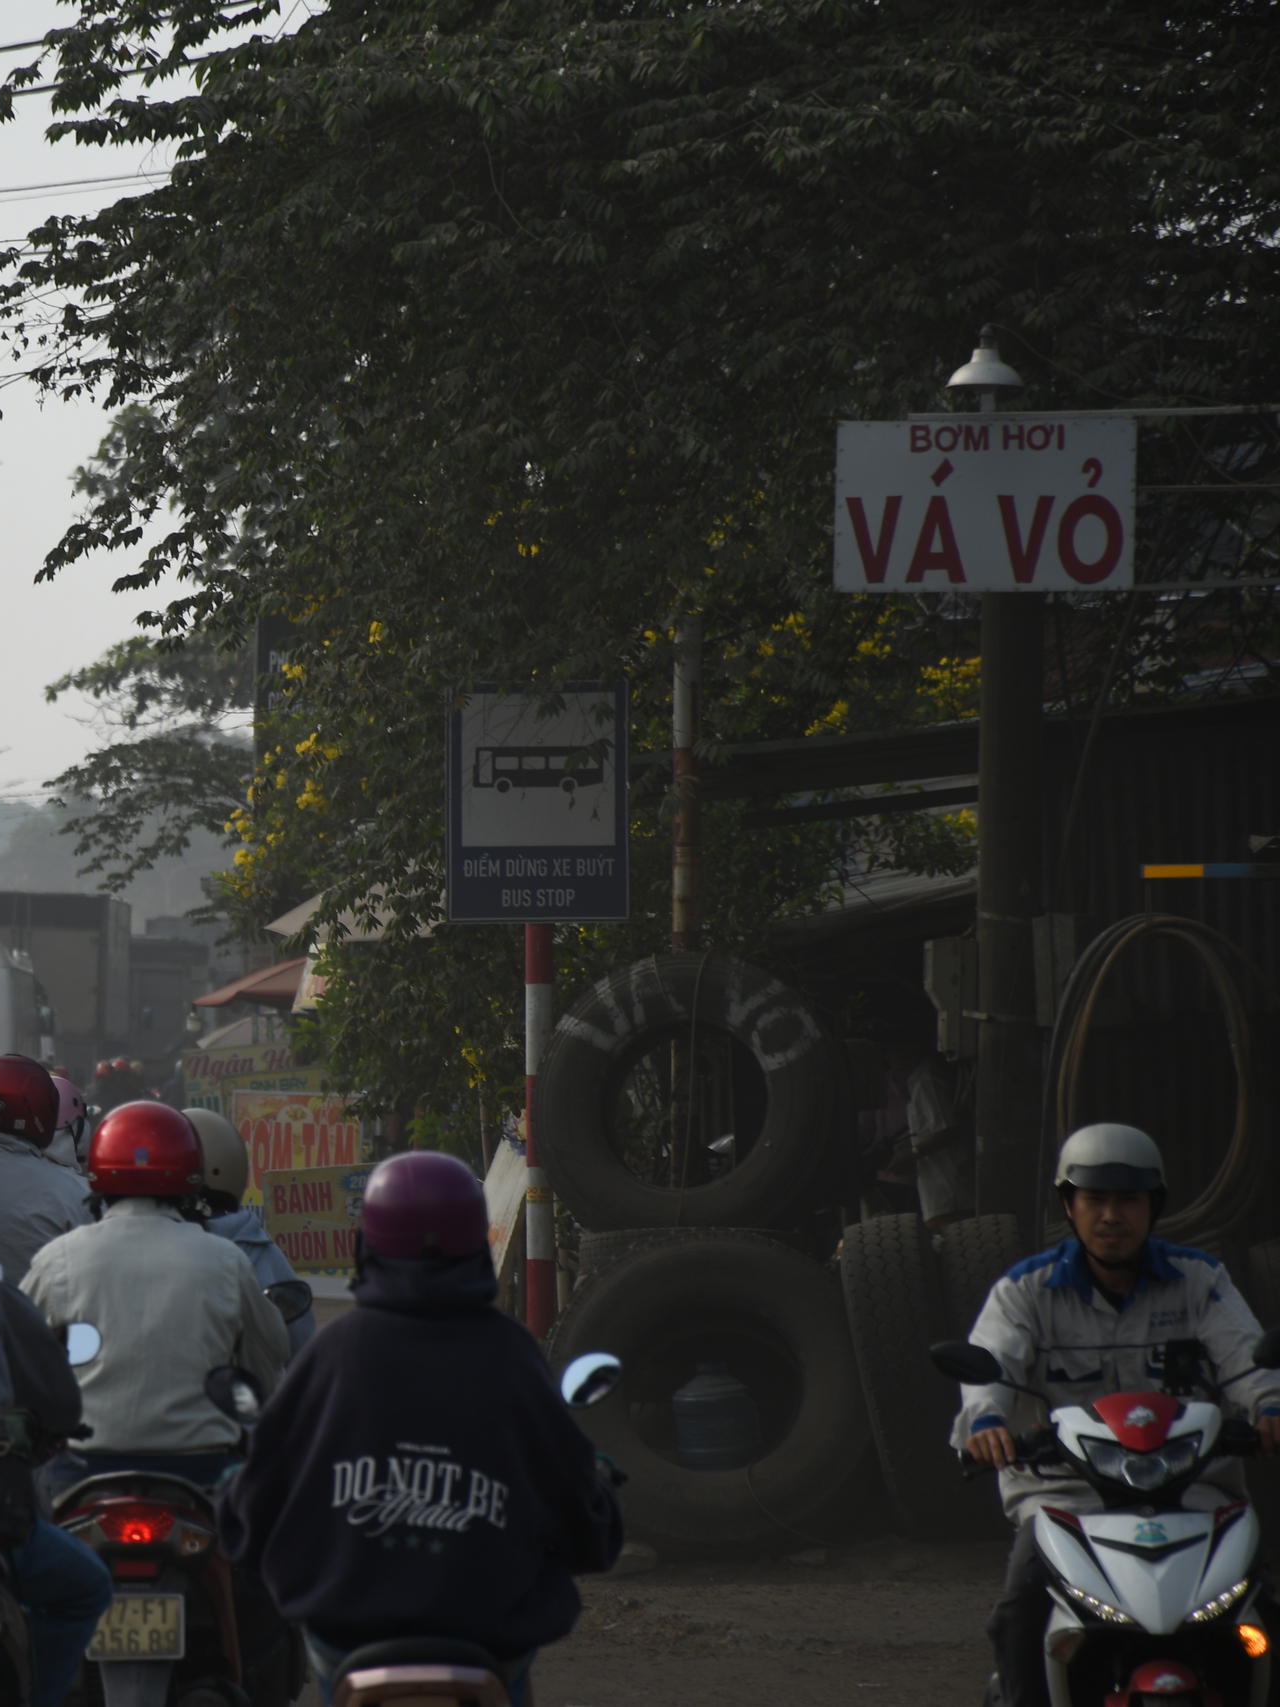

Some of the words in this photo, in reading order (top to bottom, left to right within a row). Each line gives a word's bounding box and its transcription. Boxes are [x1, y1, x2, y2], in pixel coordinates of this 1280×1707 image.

[910, 424, 989, 453] BƠM
[1002, 424, 1065, 451] HƠI
[844, 457, 968, 584] VÁ
[996, 457, 1124, 585] VỎ
[462, 852, 500, 878] ĐIỂM
[505, 854, 548, 877] DỪNG
[552, 858, 572, 877] XE
[576, 854, 615, 877] BUÝT
[501, 889, 532, 908] BUS
[536, 888, 576, 908] STOP
[187, 1053, 255, 1085] Ngân
[273, 1177, 333, 1215] BÁNH
[275, 1220, 328, 1262] CUỐN
[331, 1456, 377, 1508] DO
[386, 1457, 462, 1507] NOT
[469, 1468, 510, 1530] BE
